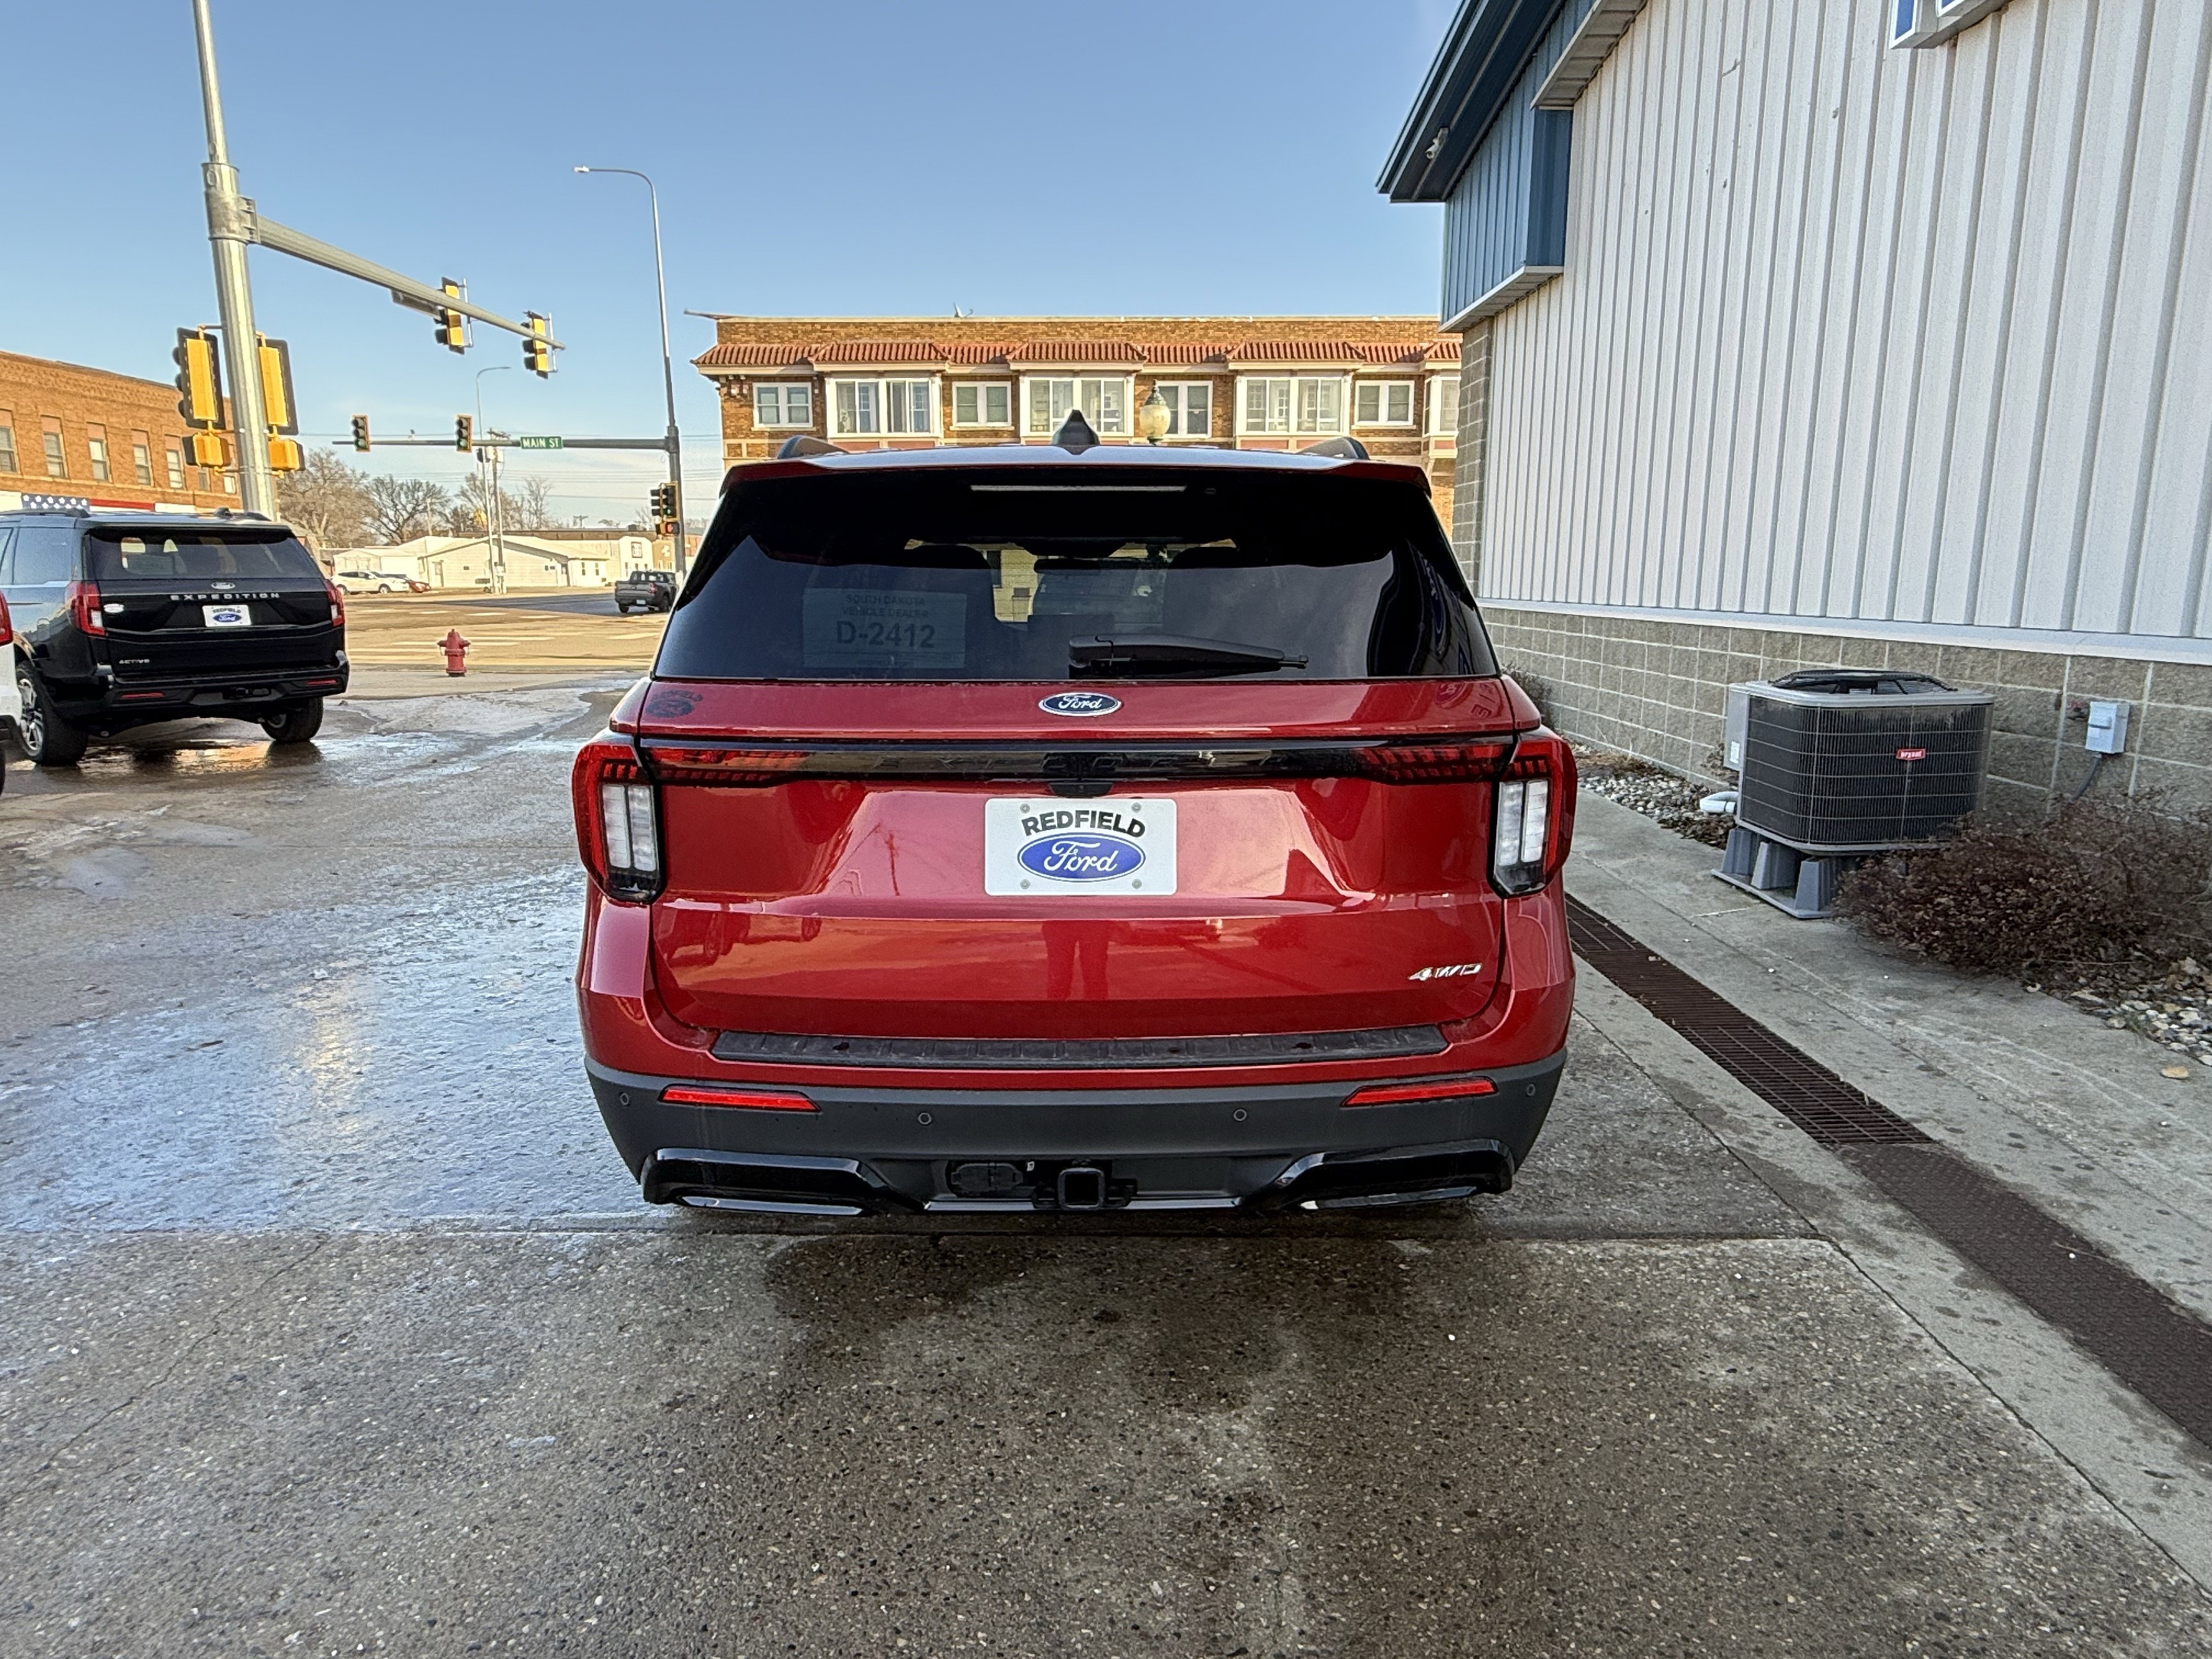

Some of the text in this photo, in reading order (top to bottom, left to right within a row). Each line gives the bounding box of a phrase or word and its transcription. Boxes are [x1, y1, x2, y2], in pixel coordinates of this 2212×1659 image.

[523, 438, 559, 448] MAIN ST
[845, 594, 926, 606] SOUTH DAKOTA
[843, 607, 928, 618] VEHICLE DEALER
[837, 620, 935, 648] D-2412
[1058, 695, 1102, 709] Ford
[1022, 810, 1145, 837] REDFIELD
[1044, 840, 1119, 871] Ford
[1408, 963, 1482, 980] 4WD
